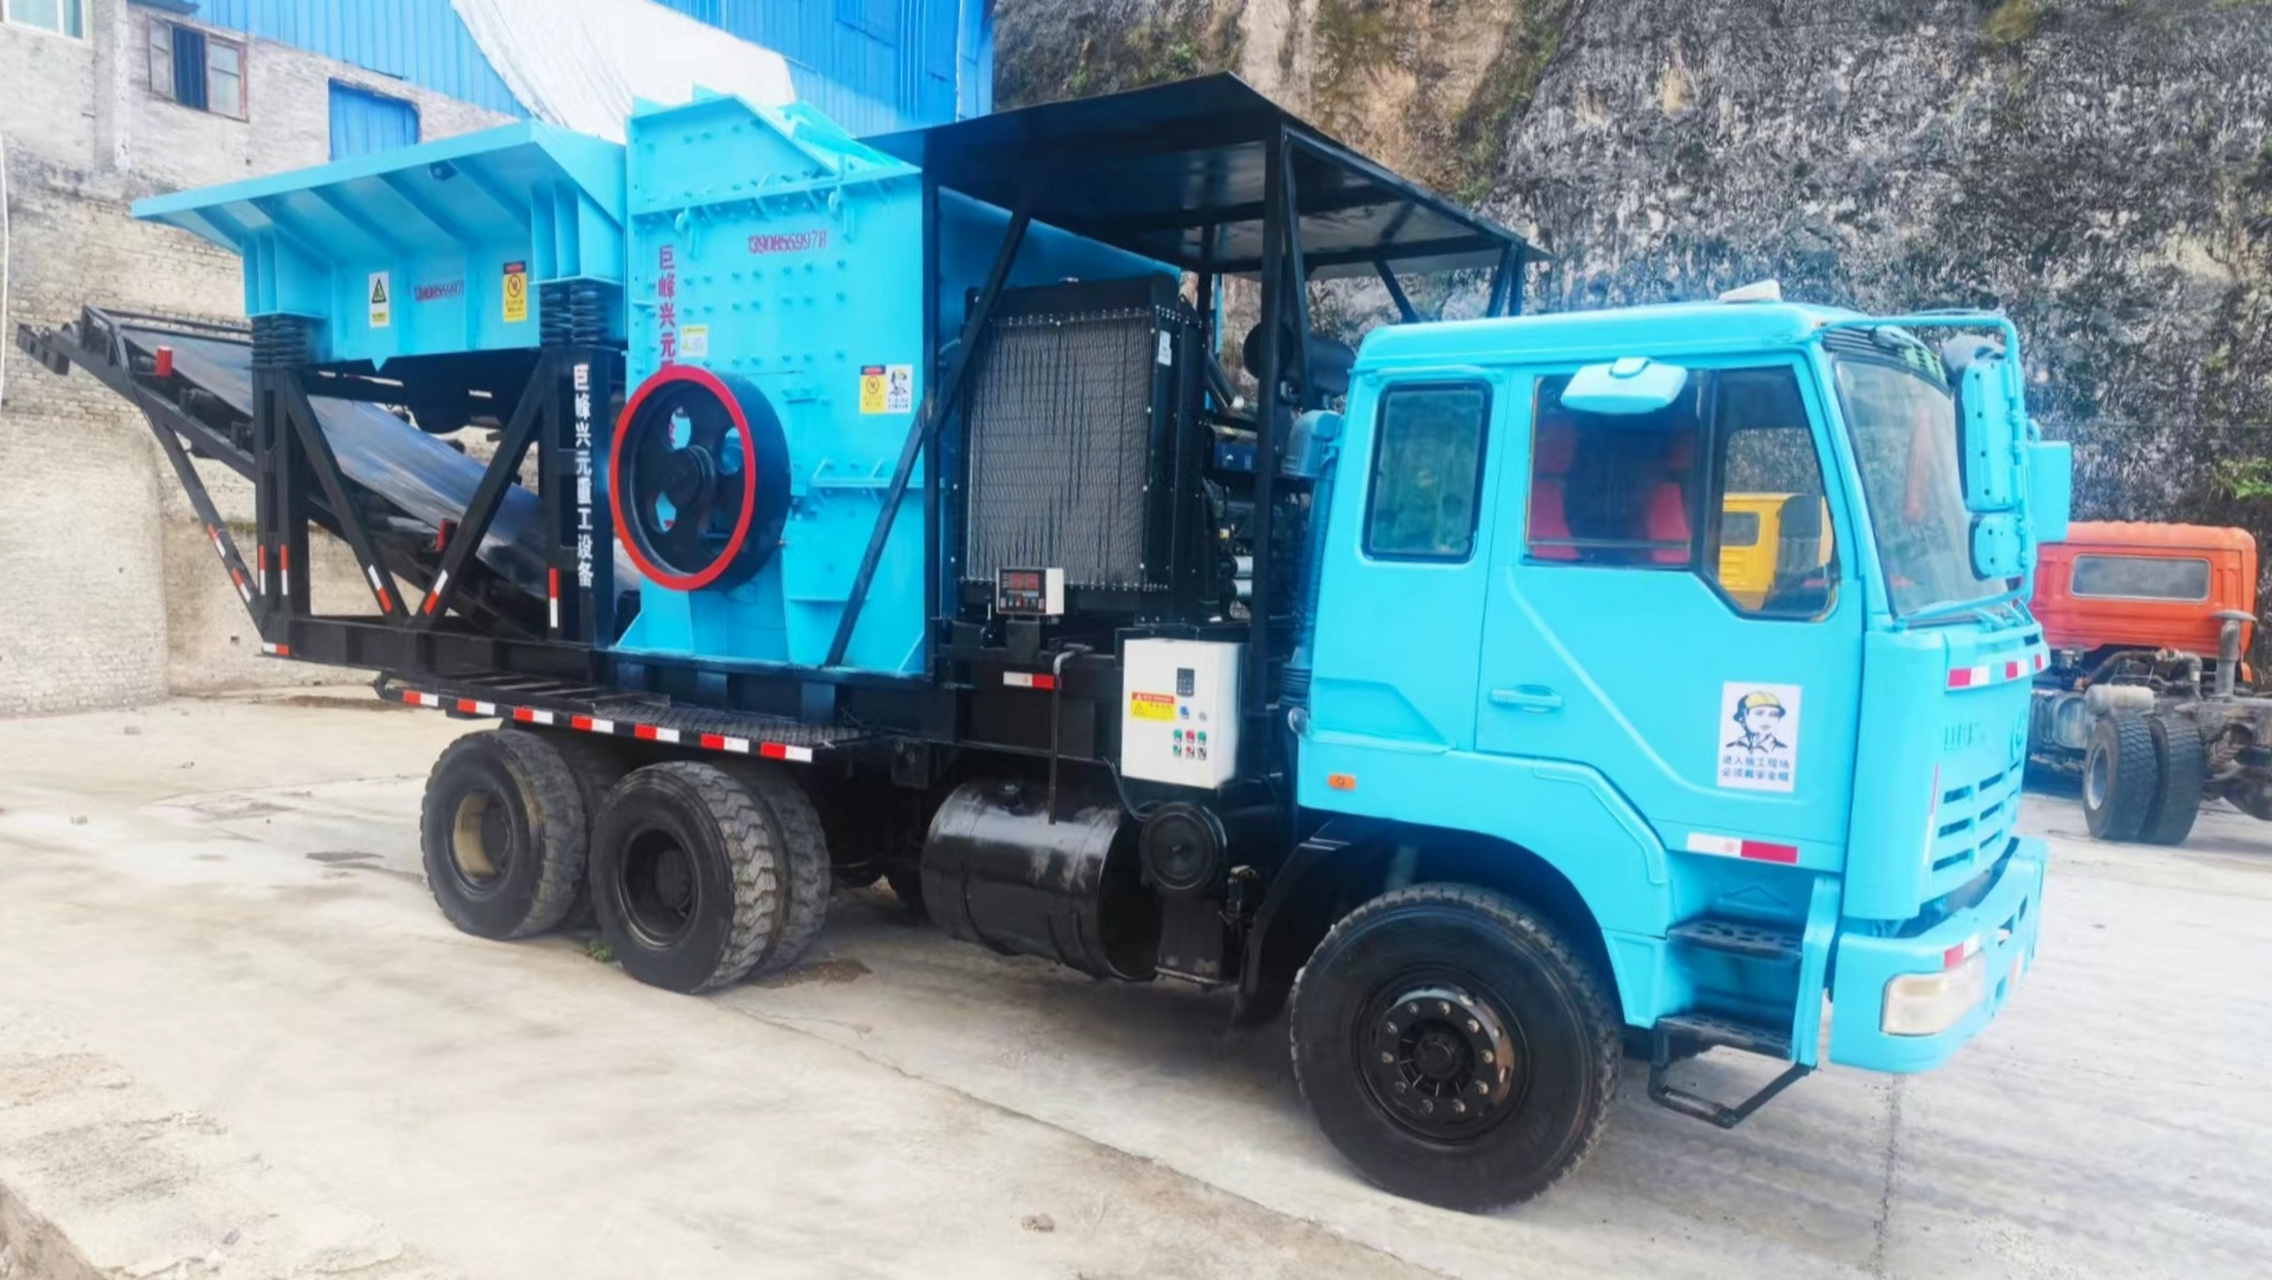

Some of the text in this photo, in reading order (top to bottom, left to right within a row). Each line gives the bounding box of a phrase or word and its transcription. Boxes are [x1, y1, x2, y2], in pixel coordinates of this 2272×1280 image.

[658, 244, 676, 366] 巨峰兴元
[573, 363, 594, 587] 巨峰兴元重工设备
